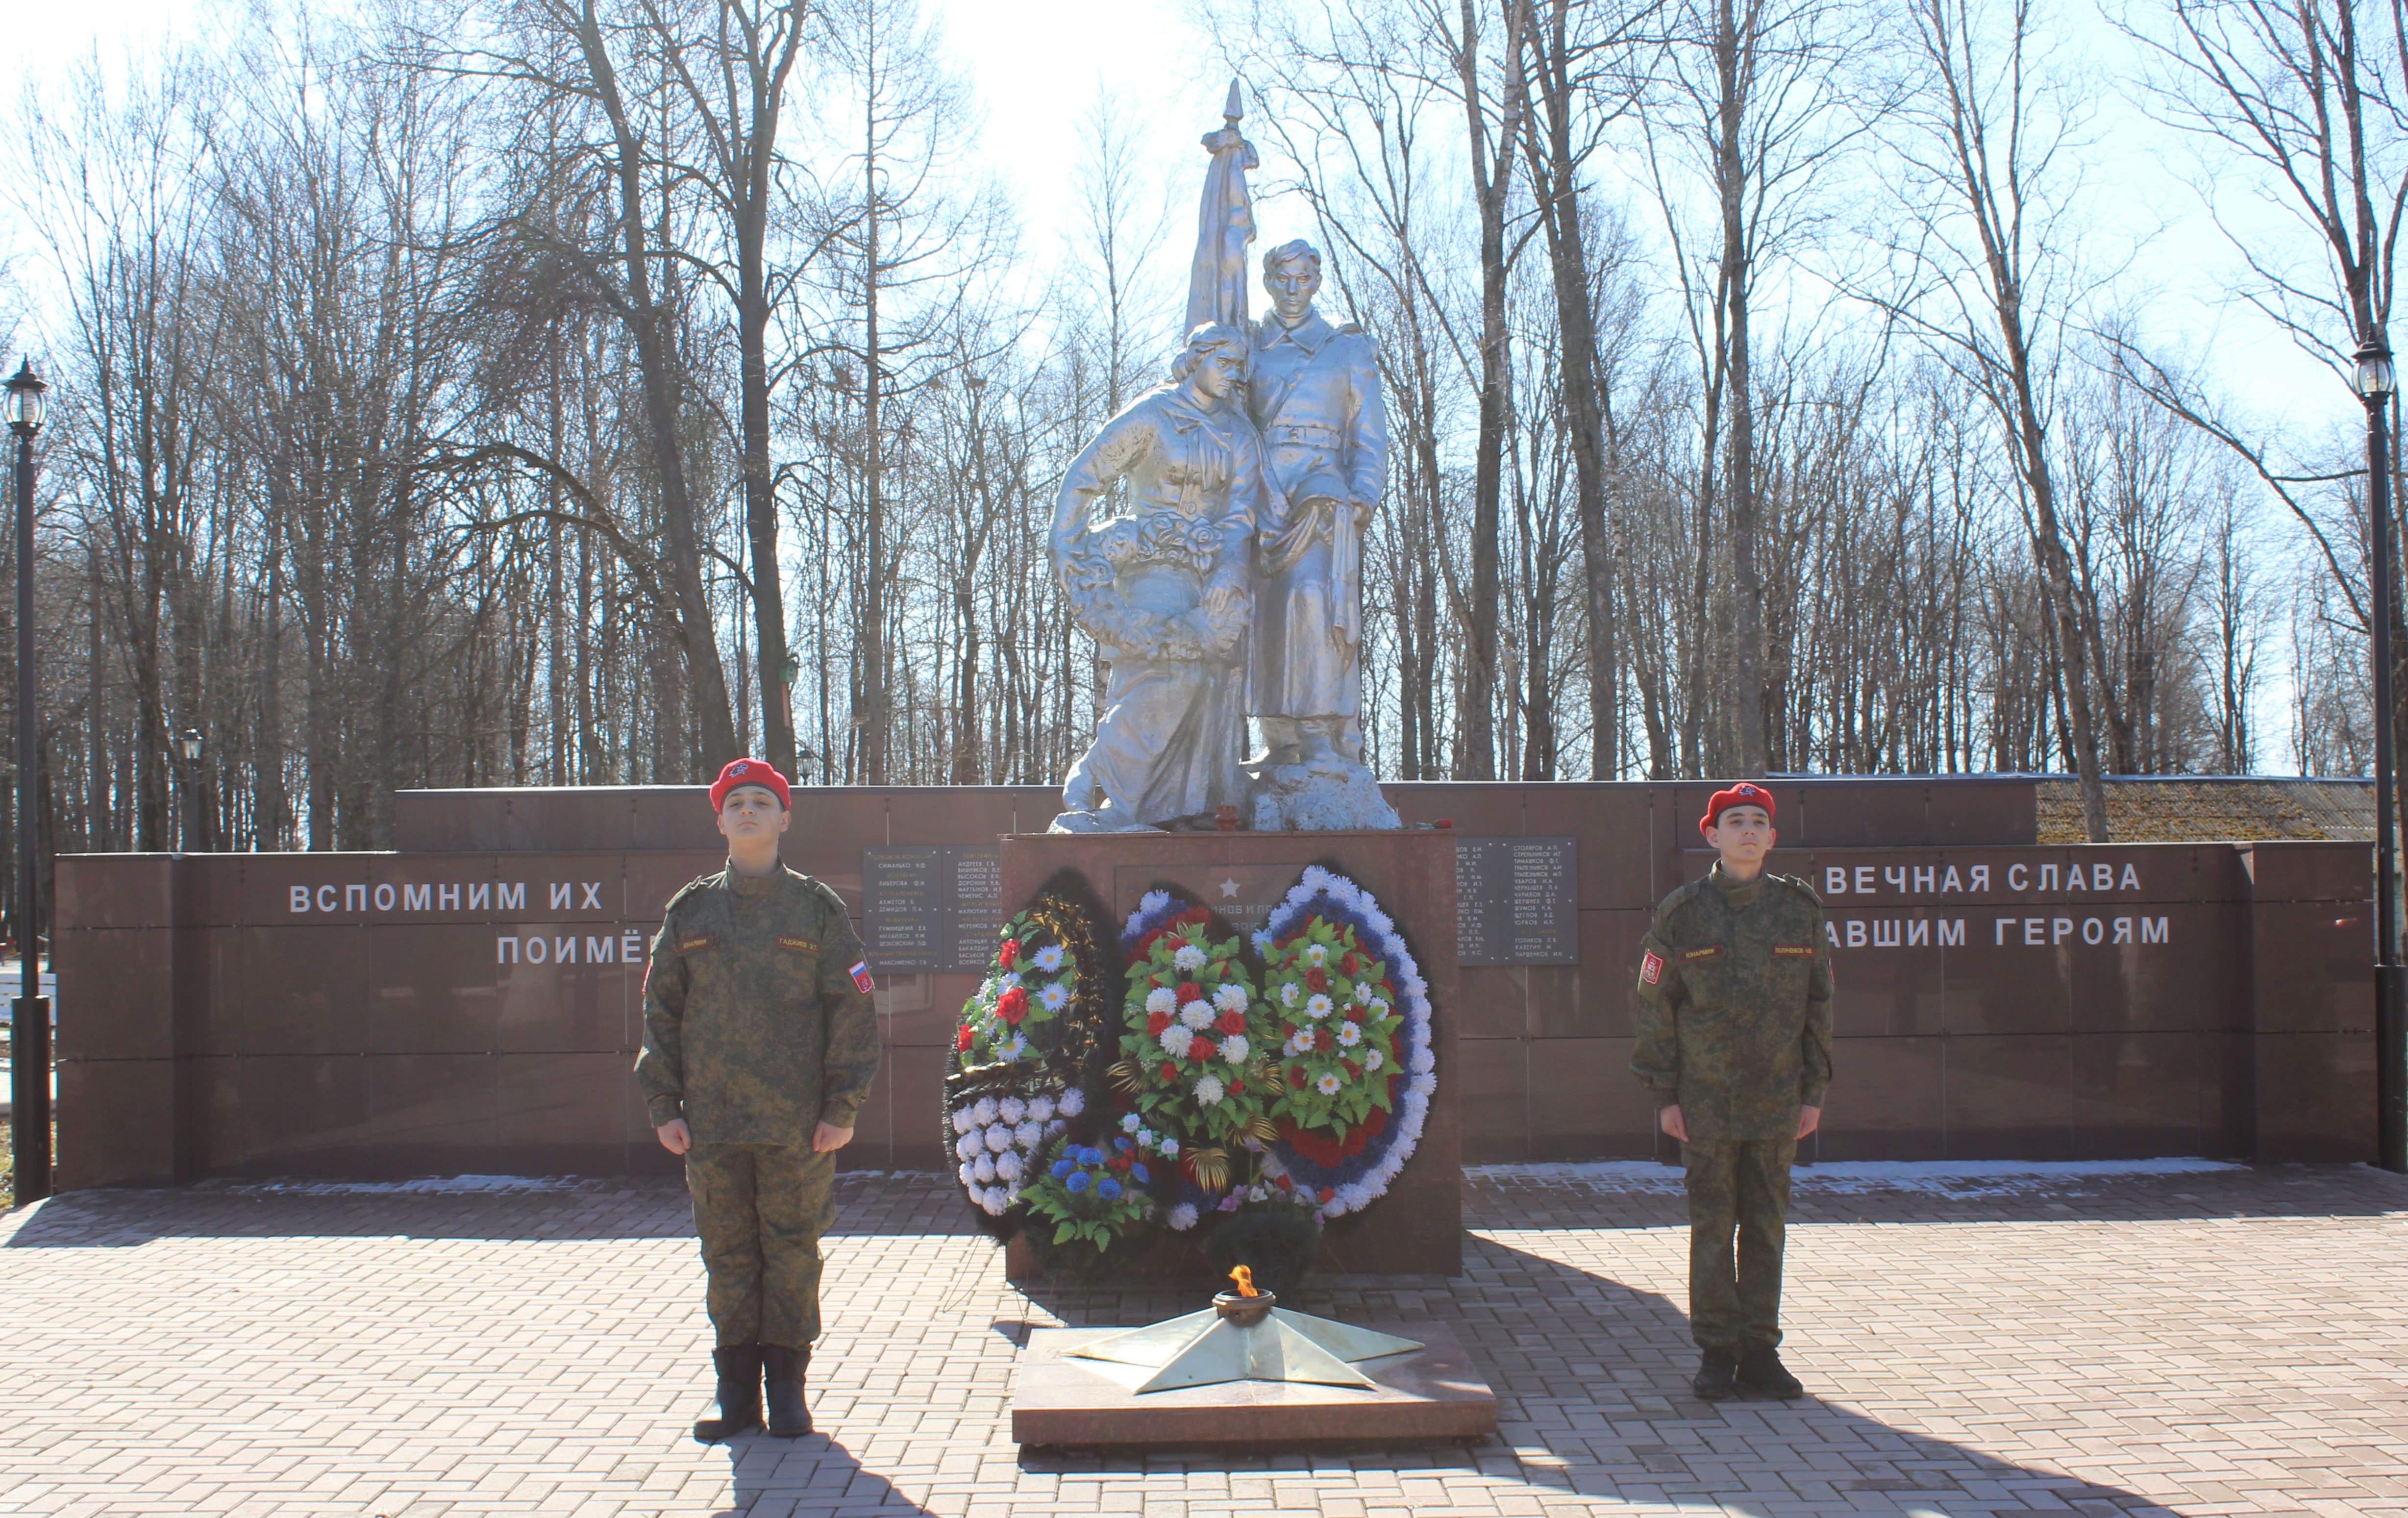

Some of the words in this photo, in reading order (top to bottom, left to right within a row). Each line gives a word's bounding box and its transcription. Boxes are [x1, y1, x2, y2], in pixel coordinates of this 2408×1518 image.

[1826, 865, 1990, 894] ВЕЧНАЯ
[2008, 863, 2141, 891] СЛАВА
[290, 883, 525, 912] ВСПОМНИМ
[550, 882, 602, 910] ИХ
[1996, 917, 2169, 946] ГЕРОЯМ
